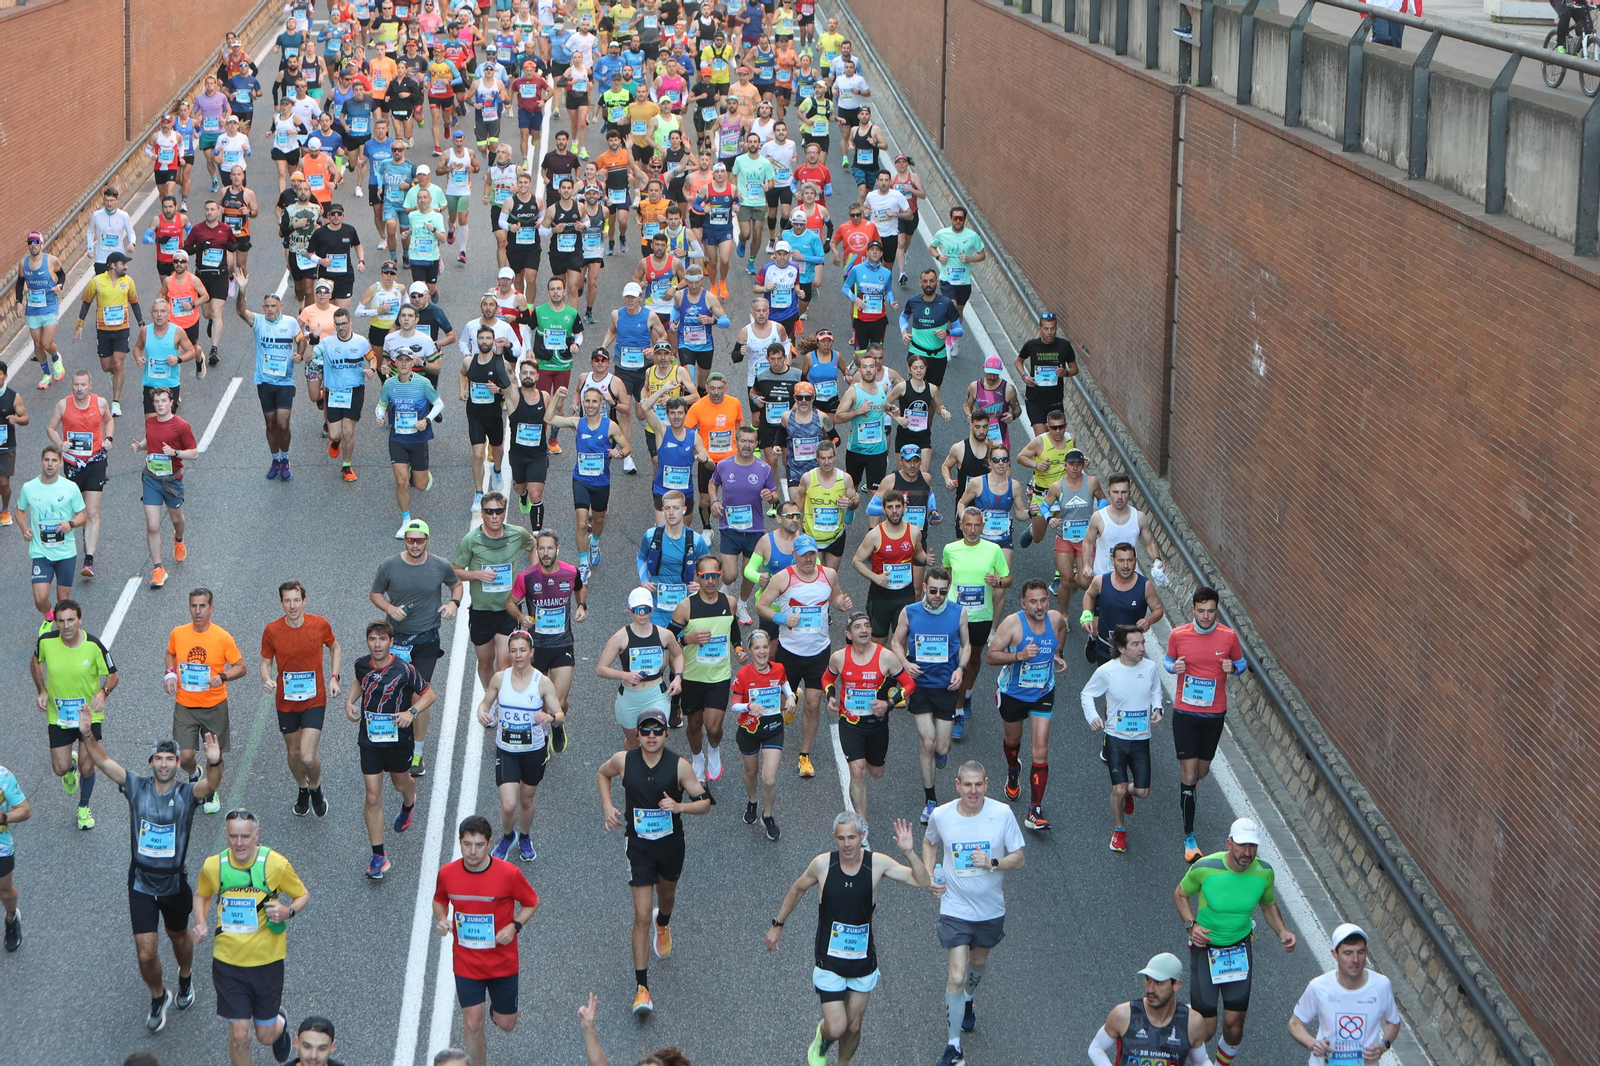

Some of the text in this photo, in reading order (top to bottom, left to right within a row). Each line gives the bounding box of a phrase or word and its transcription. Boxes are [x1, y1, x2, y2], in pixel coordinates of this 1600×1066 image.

[505, 712, 529, 721] C & C
[1150, 1050, 1170, 1058] triatlo
